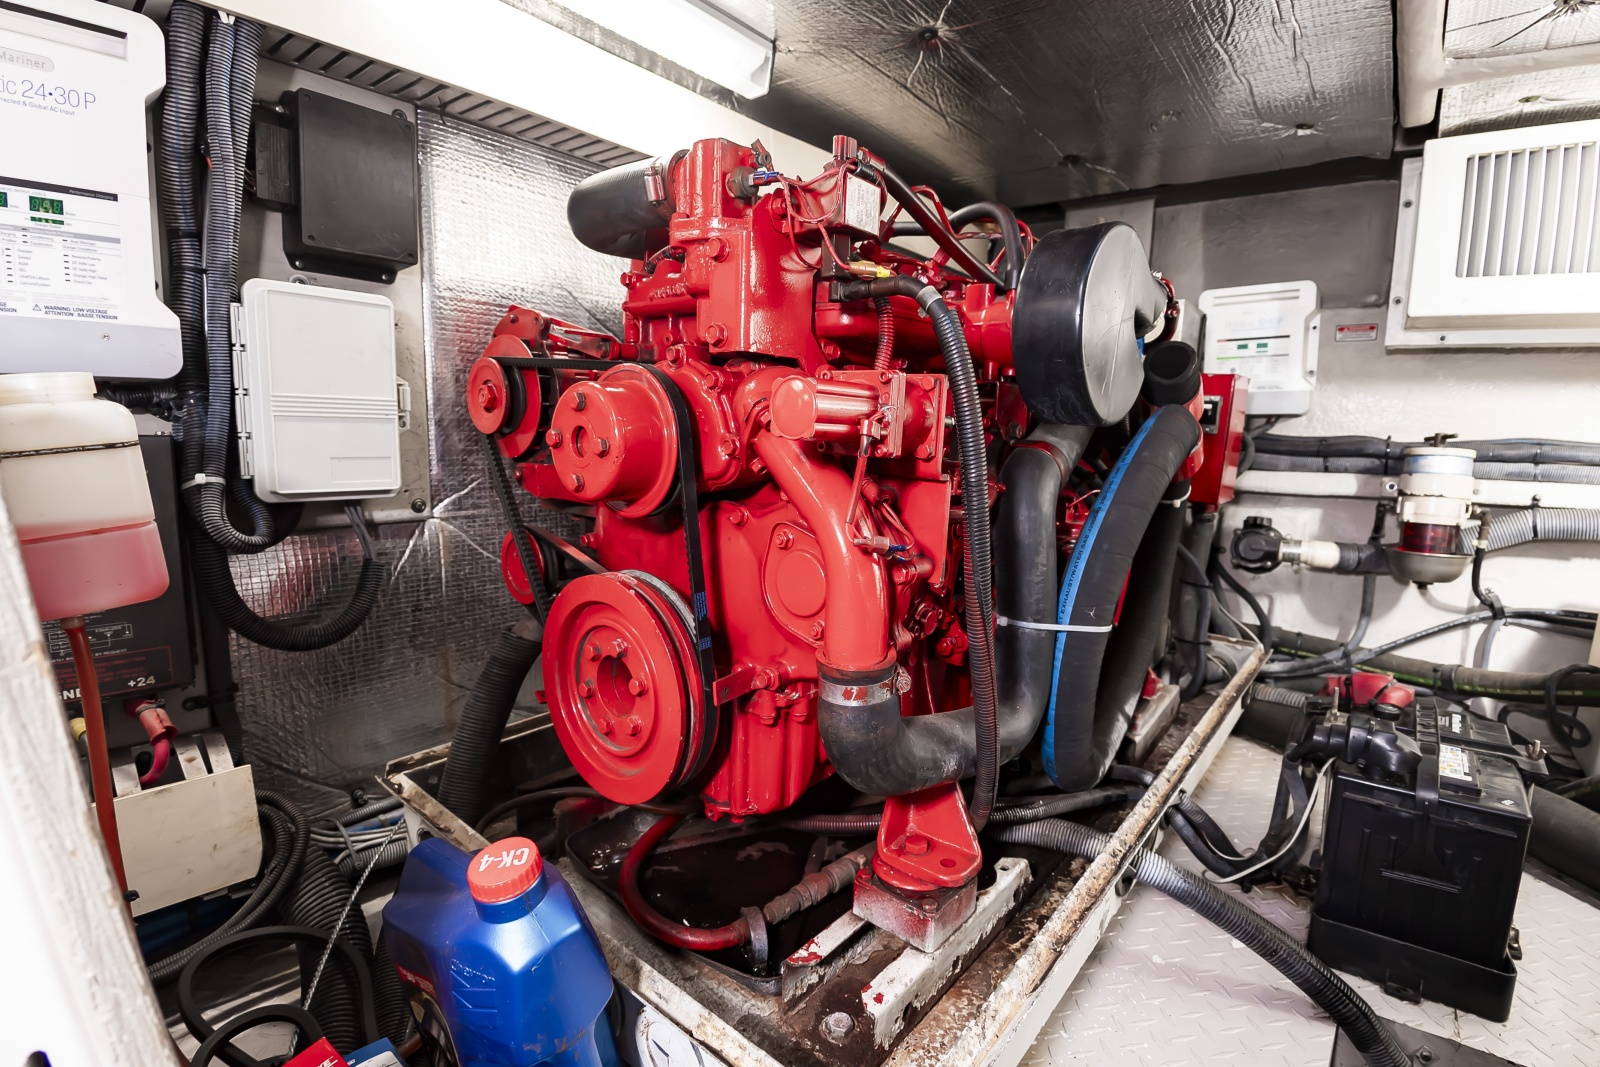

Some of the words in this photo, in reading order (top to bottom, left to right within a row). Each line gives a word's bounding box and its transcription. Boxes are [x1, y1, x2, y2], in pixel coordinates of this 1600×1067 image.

[29, 101, 48, 111] Global
[60, 107, 75, 116] Input
[1061, 550, 1084, 614] EXHAUST/WATER
[1081, 534, 1090, 551] SAE
[127, 675, 156, 687] +24
[479, 847, 530, 872] CK-4
